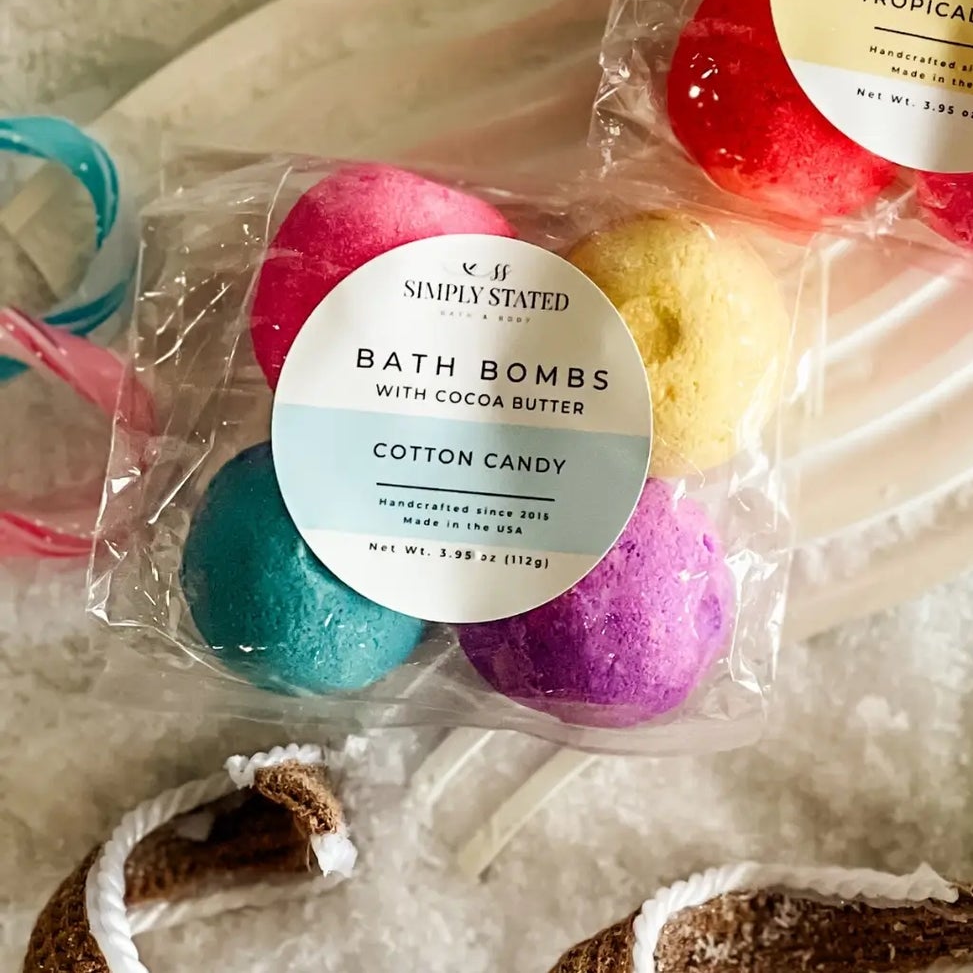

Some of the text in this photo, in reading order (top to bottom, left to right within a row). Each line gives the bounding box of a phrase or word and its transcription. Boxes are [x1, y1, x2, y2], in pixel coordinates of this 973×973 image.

[869, 46, 956, 70] Handcrafted
[891, 66, 926, 80] Made
[933, 73, 945, 83] in
[952, 78, 973, 89] the
[857, 88, 882, 101] Net
[891, 95, 915, 108] Wt.
[924, 101, 954, 115] 3.95
[403, 280, 570, 312] SIMPLY STATED
[356, 348, 609, 391] BATH BOMBS
[376, 384, 584, 415] WITH COCOA BUTTER
[373, 442, 567, 475] COTTON CANDY
[379, 498, 549, 521] Handcrafted since 2015
[403, 517, 523, 535] Made in the USA
[369, 543, 549, 569] Net Wt. 3.95 oz (112g)
